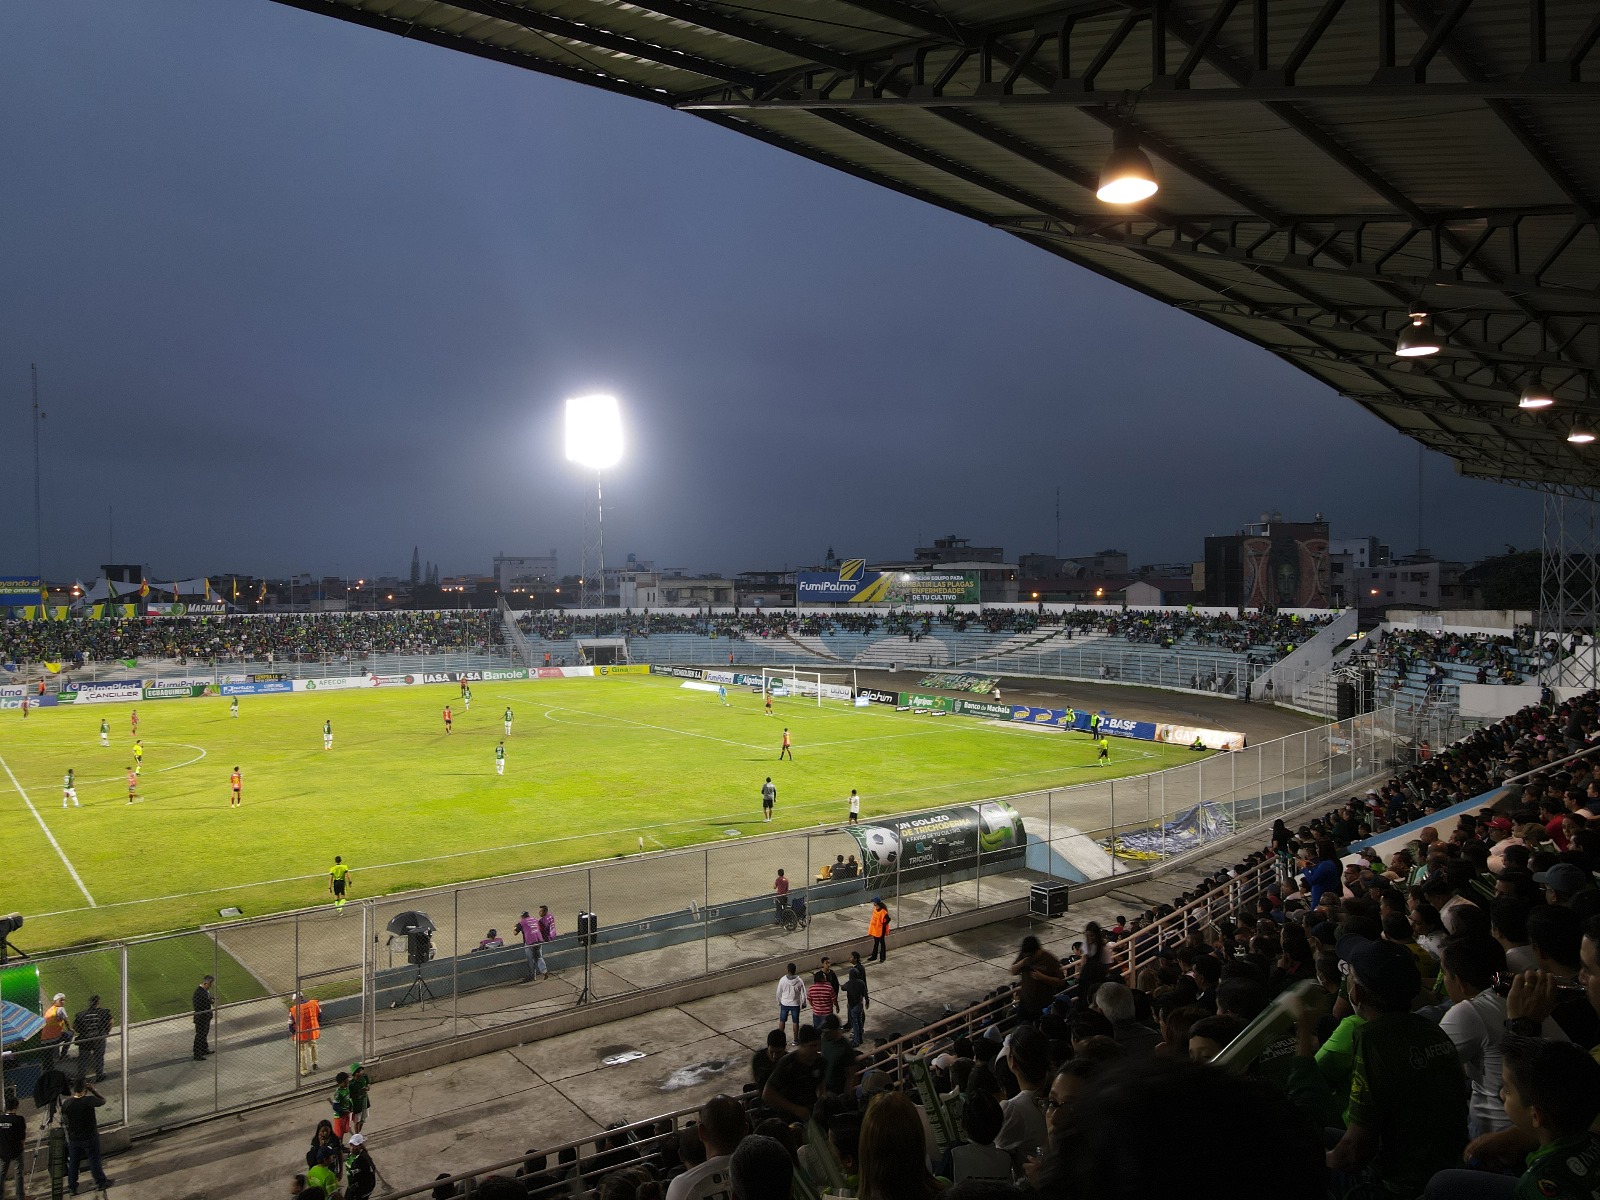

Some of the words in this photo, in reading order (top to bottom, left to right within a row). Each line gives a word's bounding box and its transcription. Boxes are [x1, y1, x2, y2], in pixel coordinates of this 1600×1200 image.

[32, 579, 40, 587] al
[799, 581, 857, 591] FumiPalma
[187, 603, 226, 613] MACHALA
[424, 673, 450, 683] IASA
[483, 670, 523, 680] Banole
[318, 678, 347, 686] AFECOR
[80, 683, 136, 693] PalmaPlast
[147, 688, 191, 697] ECUAQUIMICA
[89, 691, 139, 700] CANCILLER
[963, 701, 981, 710] Banco
[987, 704, 1010, 714] Machala
[1109, 718, 1137, 731] BASF
[895, 821, 910, 830] UN
[911, 815, 950, 827] GOLAZO
[901, 828, 913, 837] DE
[915, 818, 973, 834] TRICHODERMA
